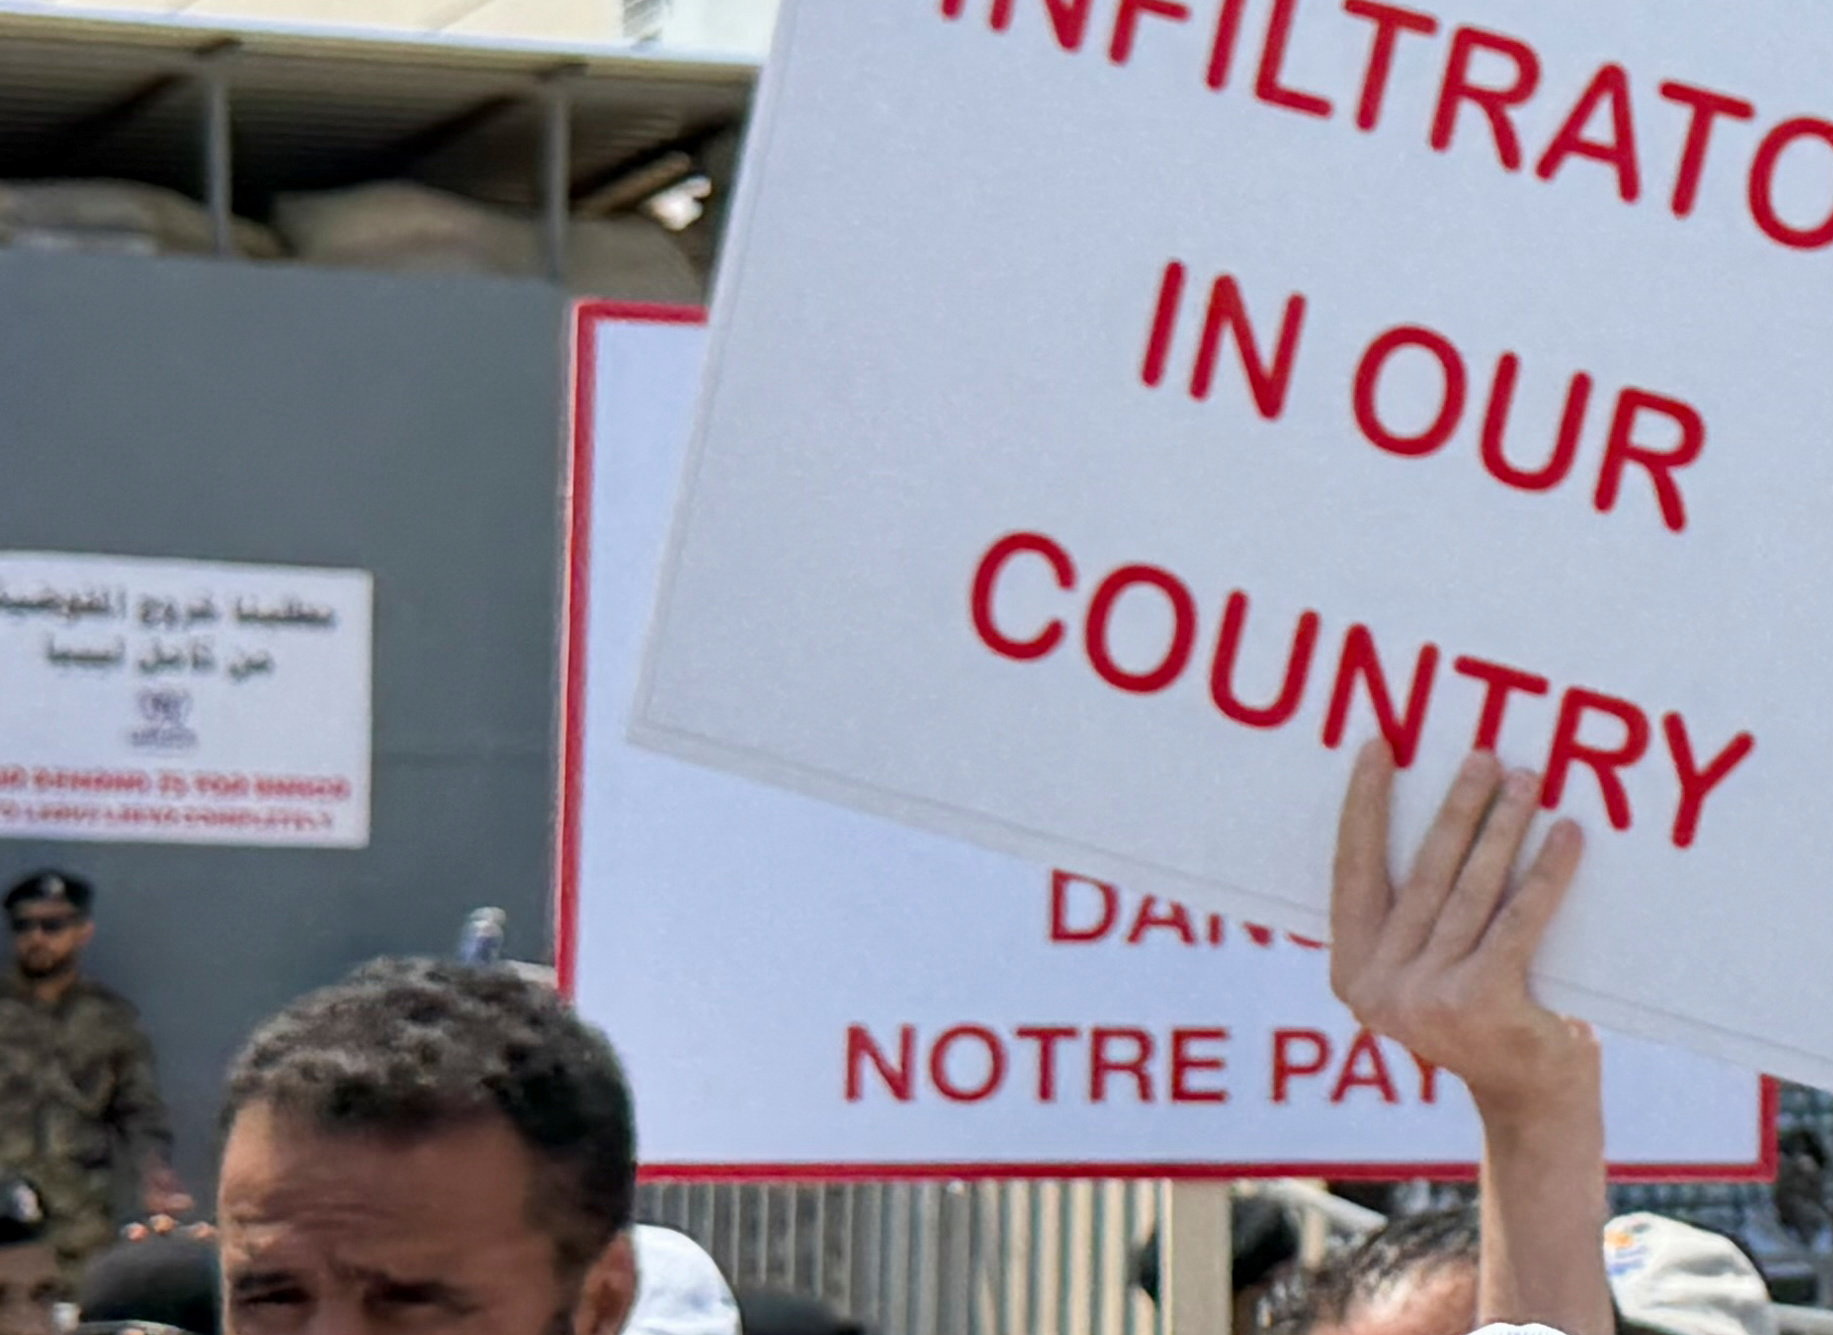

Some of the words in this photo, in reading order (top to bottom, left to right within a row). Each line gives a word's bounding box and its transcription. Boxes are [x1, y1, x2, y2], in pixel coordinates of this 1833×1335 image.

[1140, 260, 1306, 421] IN
[1352, 325, 1706, 533] OUR
[970, 531, 1755, 850] COUNTRY
[1049, 869, 1331, 949] DA
[846, 1025, 1226, 1103] NOTRE
[1272, 1026, 1442, 1103] PAY
